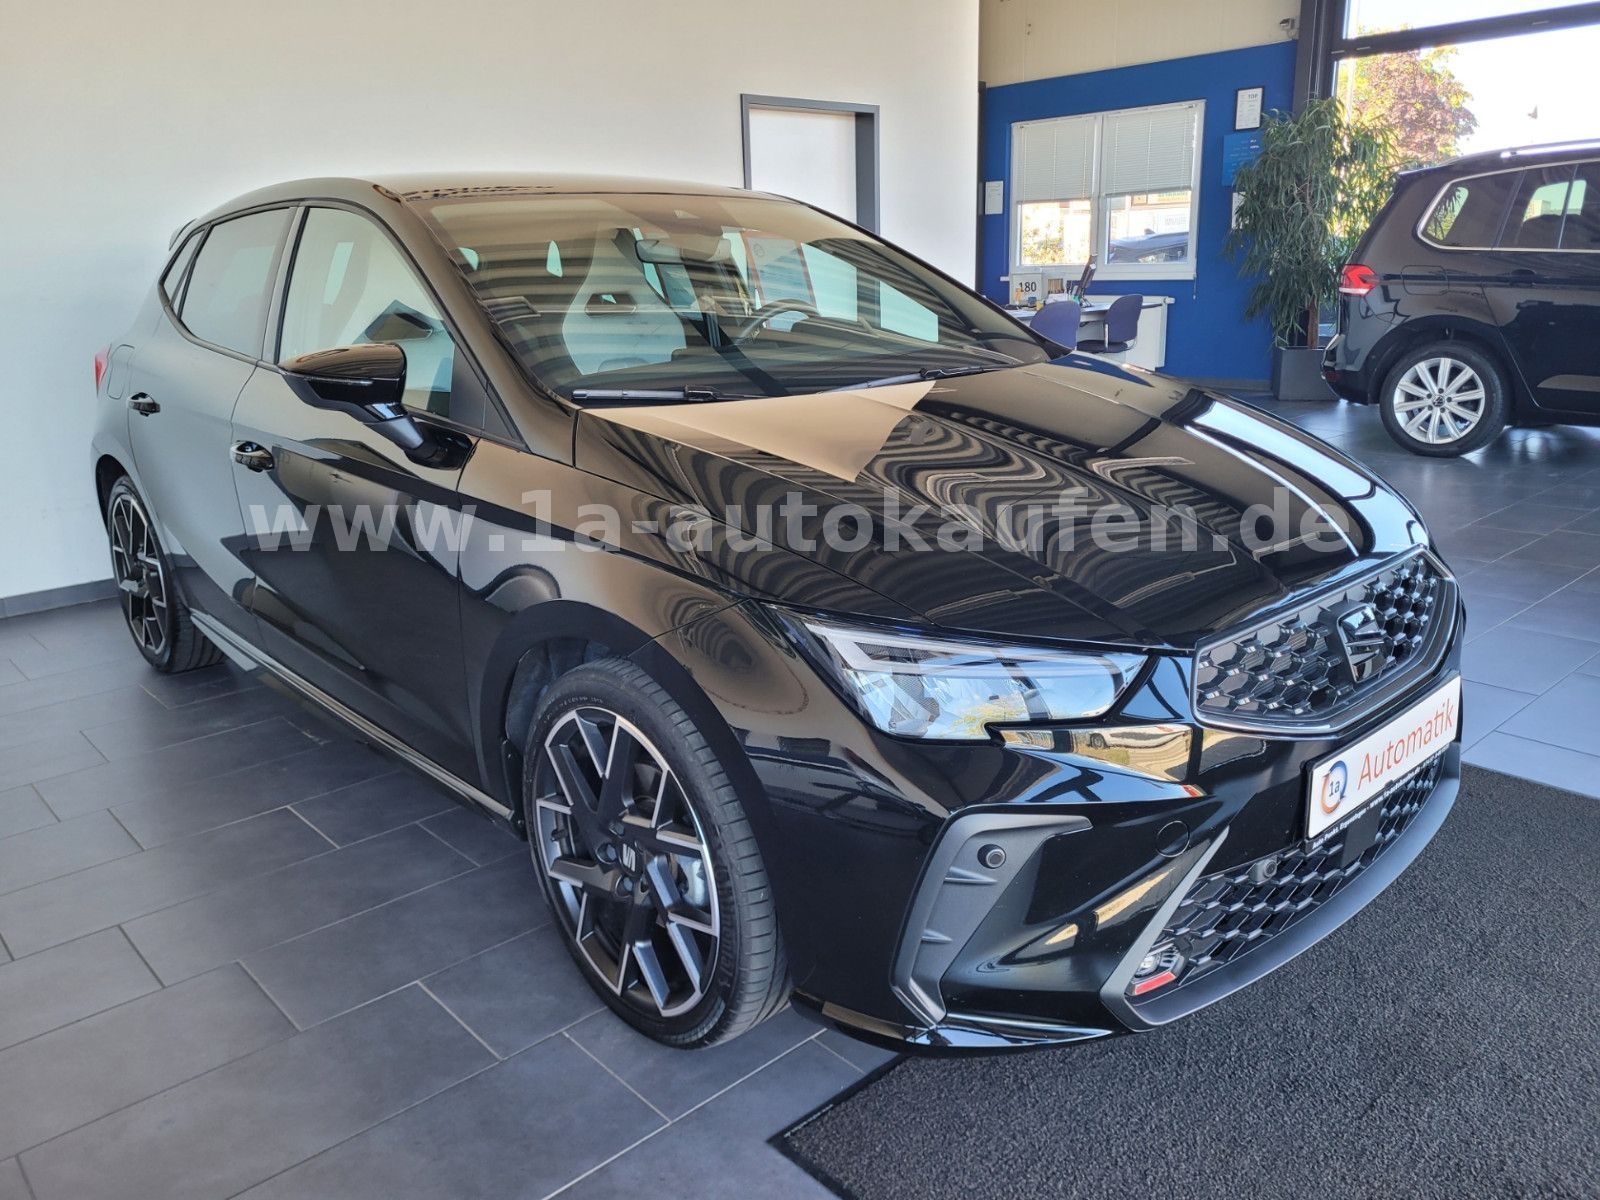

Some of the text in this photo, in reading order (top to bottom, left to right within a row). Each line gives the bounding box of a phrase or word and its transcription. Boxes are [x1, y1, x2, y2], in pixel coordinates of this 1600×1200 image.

[1019, 282, 1036, 292] 180
[1328, 779, 1341, 797] 1a
[1358, 698, 1454, 790] Automatik
